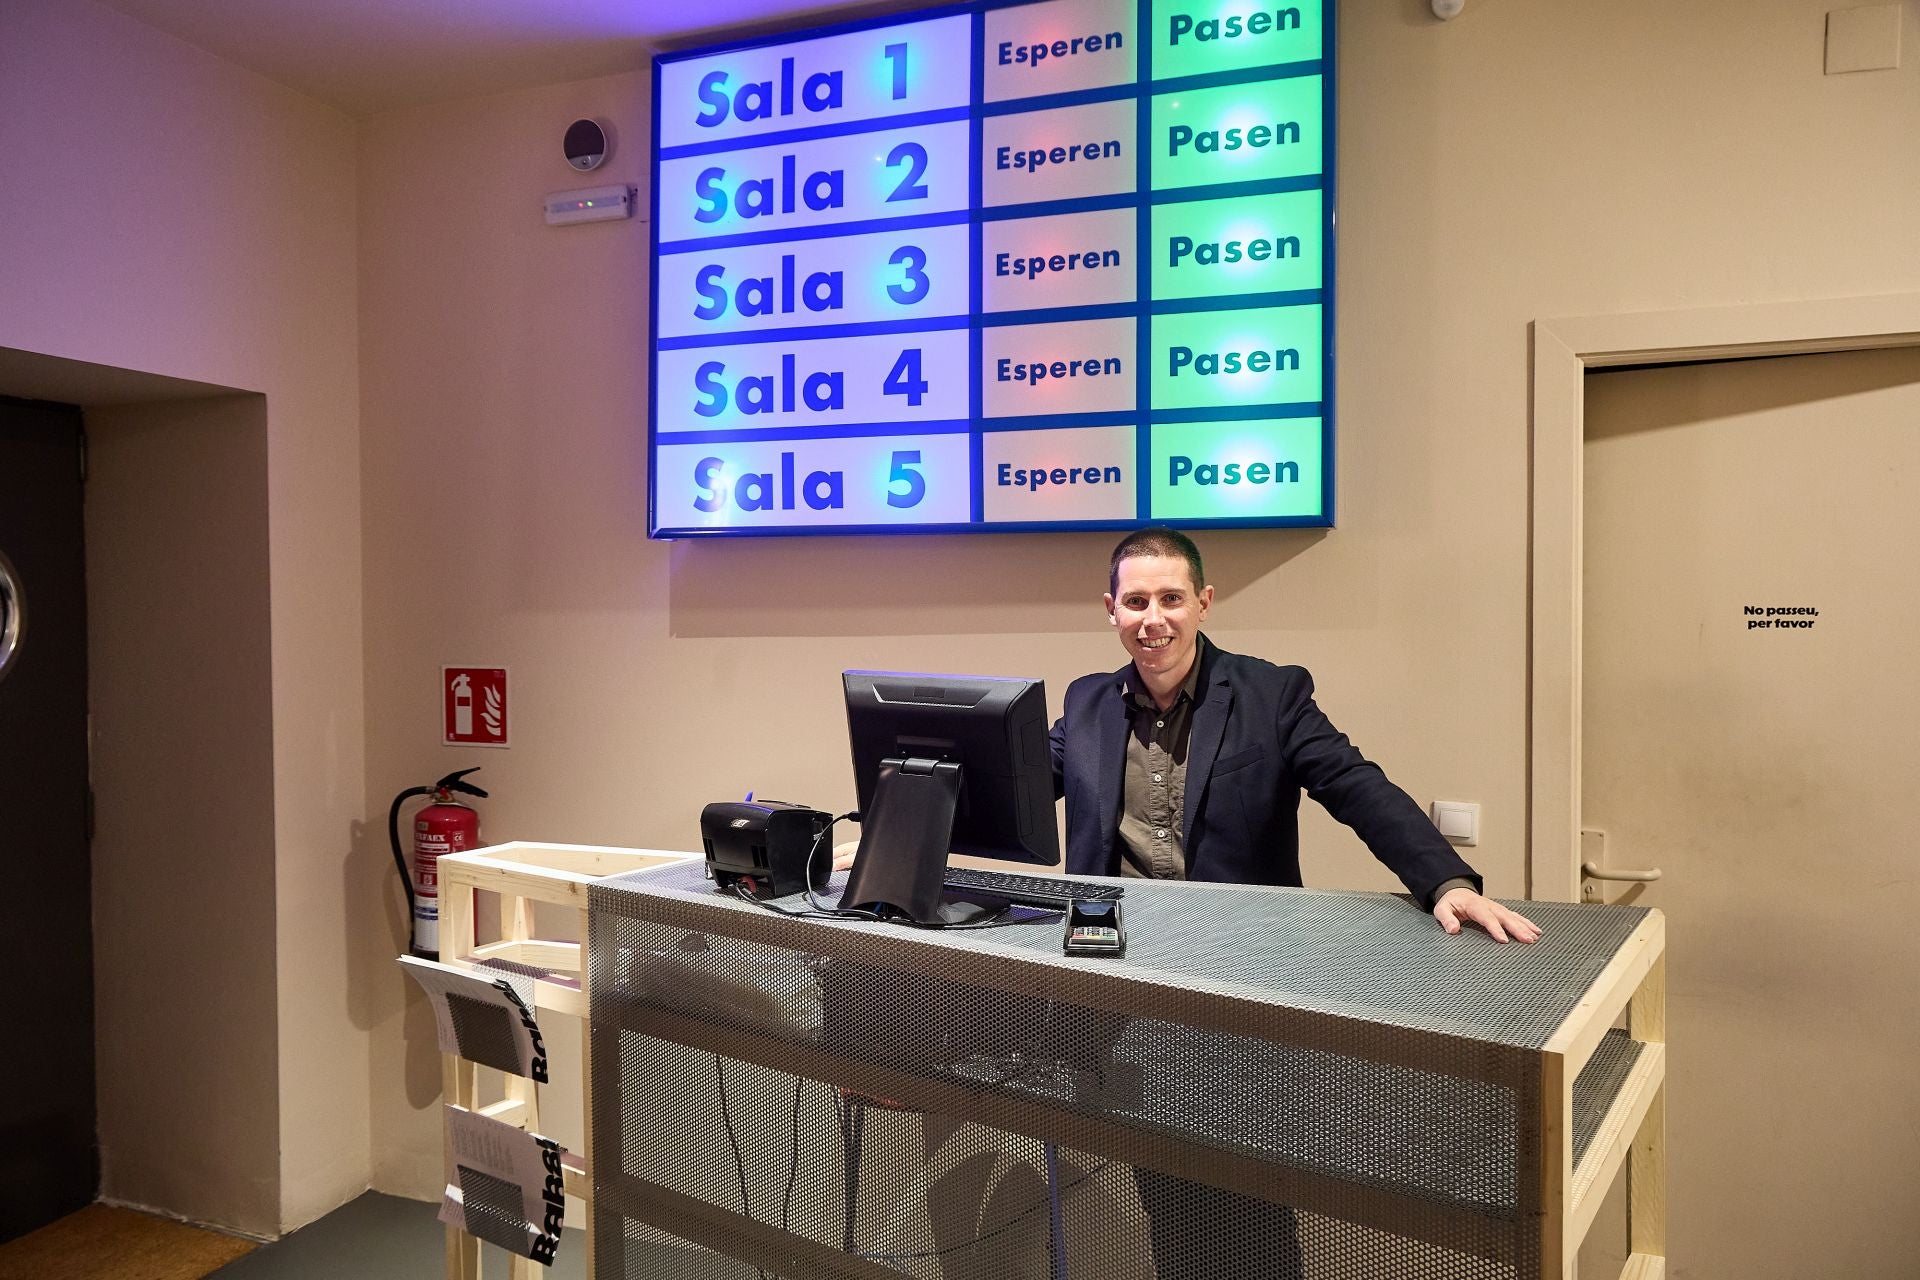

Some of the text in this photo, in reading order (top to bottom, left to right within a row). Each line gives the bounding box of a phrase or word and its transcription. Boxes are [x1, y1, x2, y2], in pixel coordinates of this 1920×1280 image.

[1170, 7, 1301, 46] Pasen
[999, 31, 1123, 66] Esperen
[694, 42, 911, 129] Sala 1
[1170, 120, 1300, 156] Pasen
[997, 140, 1121, 171] Esperen
[694, 142, 928, 223] Sala 2
[997, 249, 1120, 279] Esperen
[1170, 235, 1300, 267] Pasen
[694, 246, 930, 321] Sala 3
[998, 357, 1121, 385] Esperen
[1170, 346, 1300, 377] Pasen
[694, 349, 928, 417] Sala 4
[694, 450, 926, 512] Sala 5
[998, 464, 1121, 489] Esperen
[1170, 456, 1299, 486] Pasen
[1743, 605, 1819, 617] No passeu,
[1747, 618, 1815, 630] per favor
